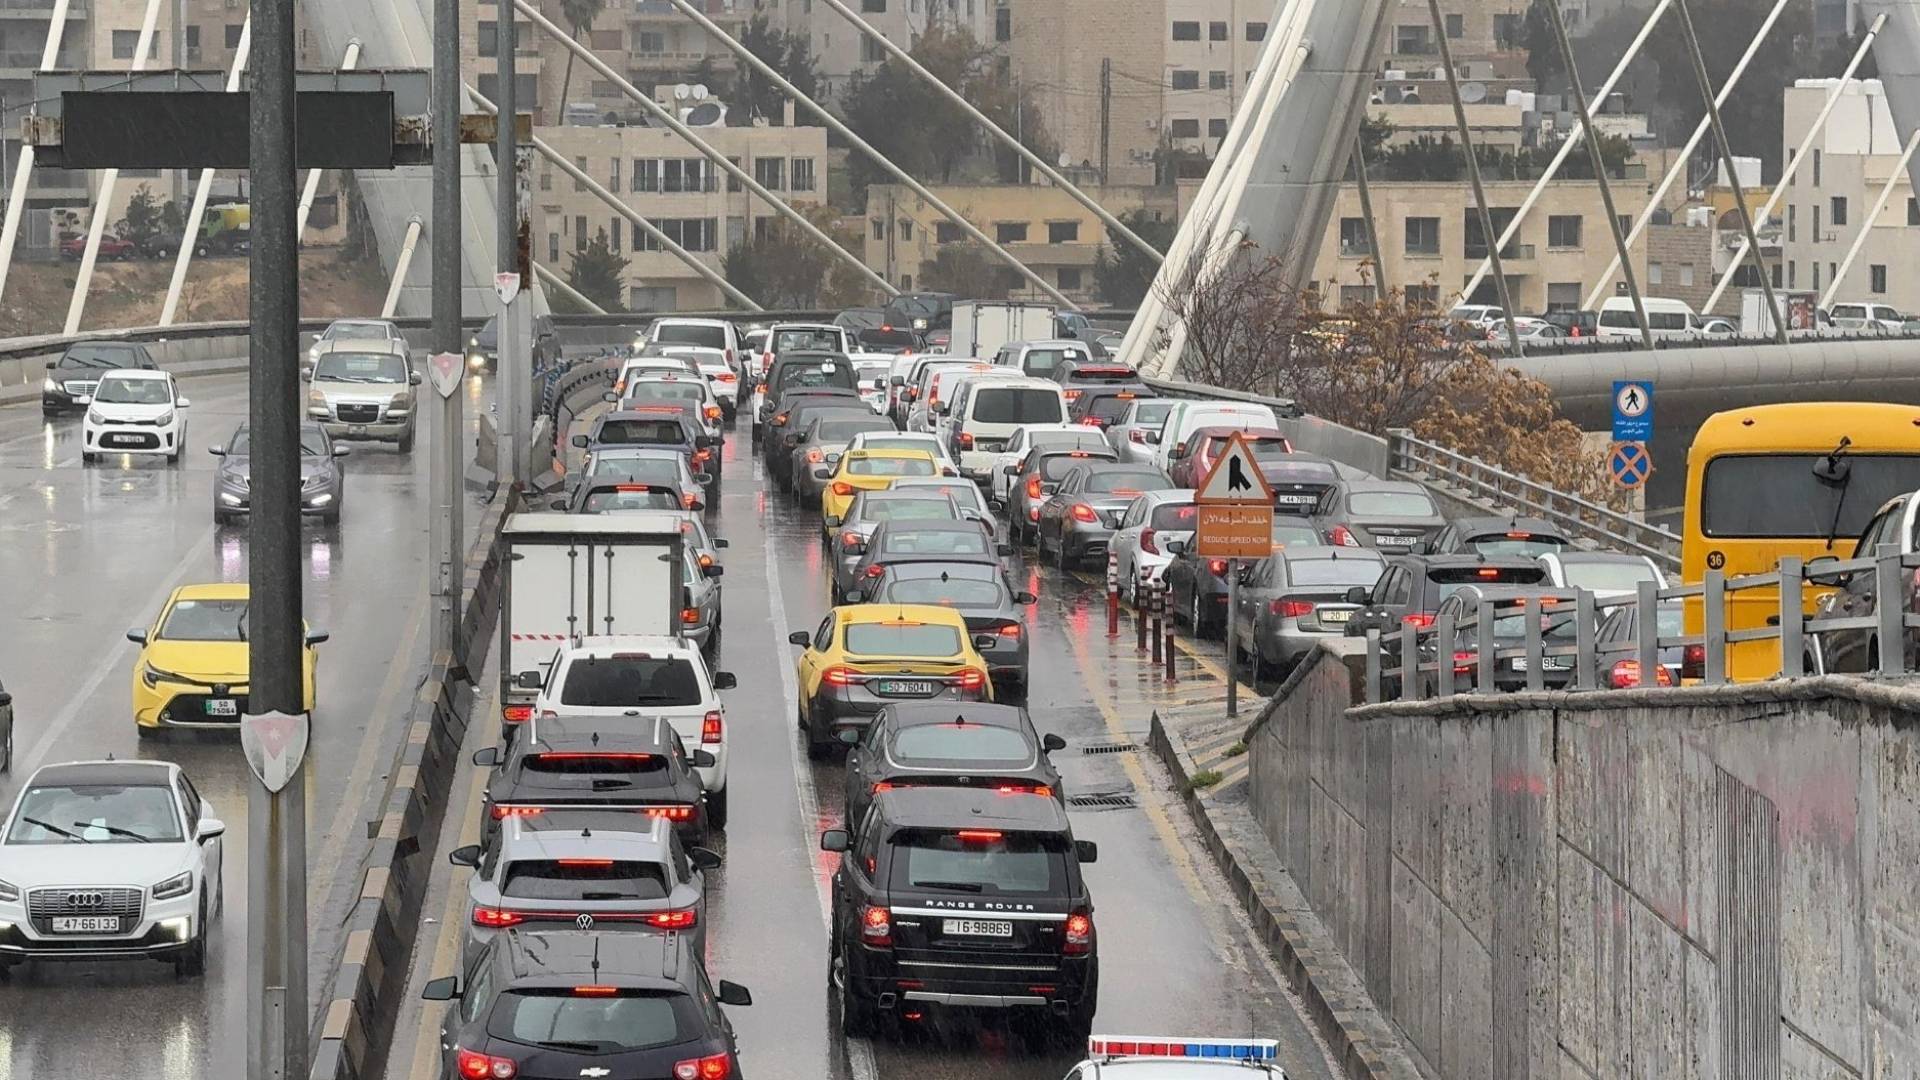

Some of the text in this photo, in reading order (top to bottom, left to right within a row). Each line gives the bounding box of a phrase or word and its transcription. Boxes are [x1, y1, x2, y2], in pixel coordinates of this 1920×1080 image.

[1203, 535, 1268, 544] REDUCE SPEED NOW
[1709, 554, 1722, 567] 36
[926, 900, 1034, 911] RANGE ROVER
[64, 919, 118, 929] 47-66133
[957, 921, 1011, 934] 16-98869
